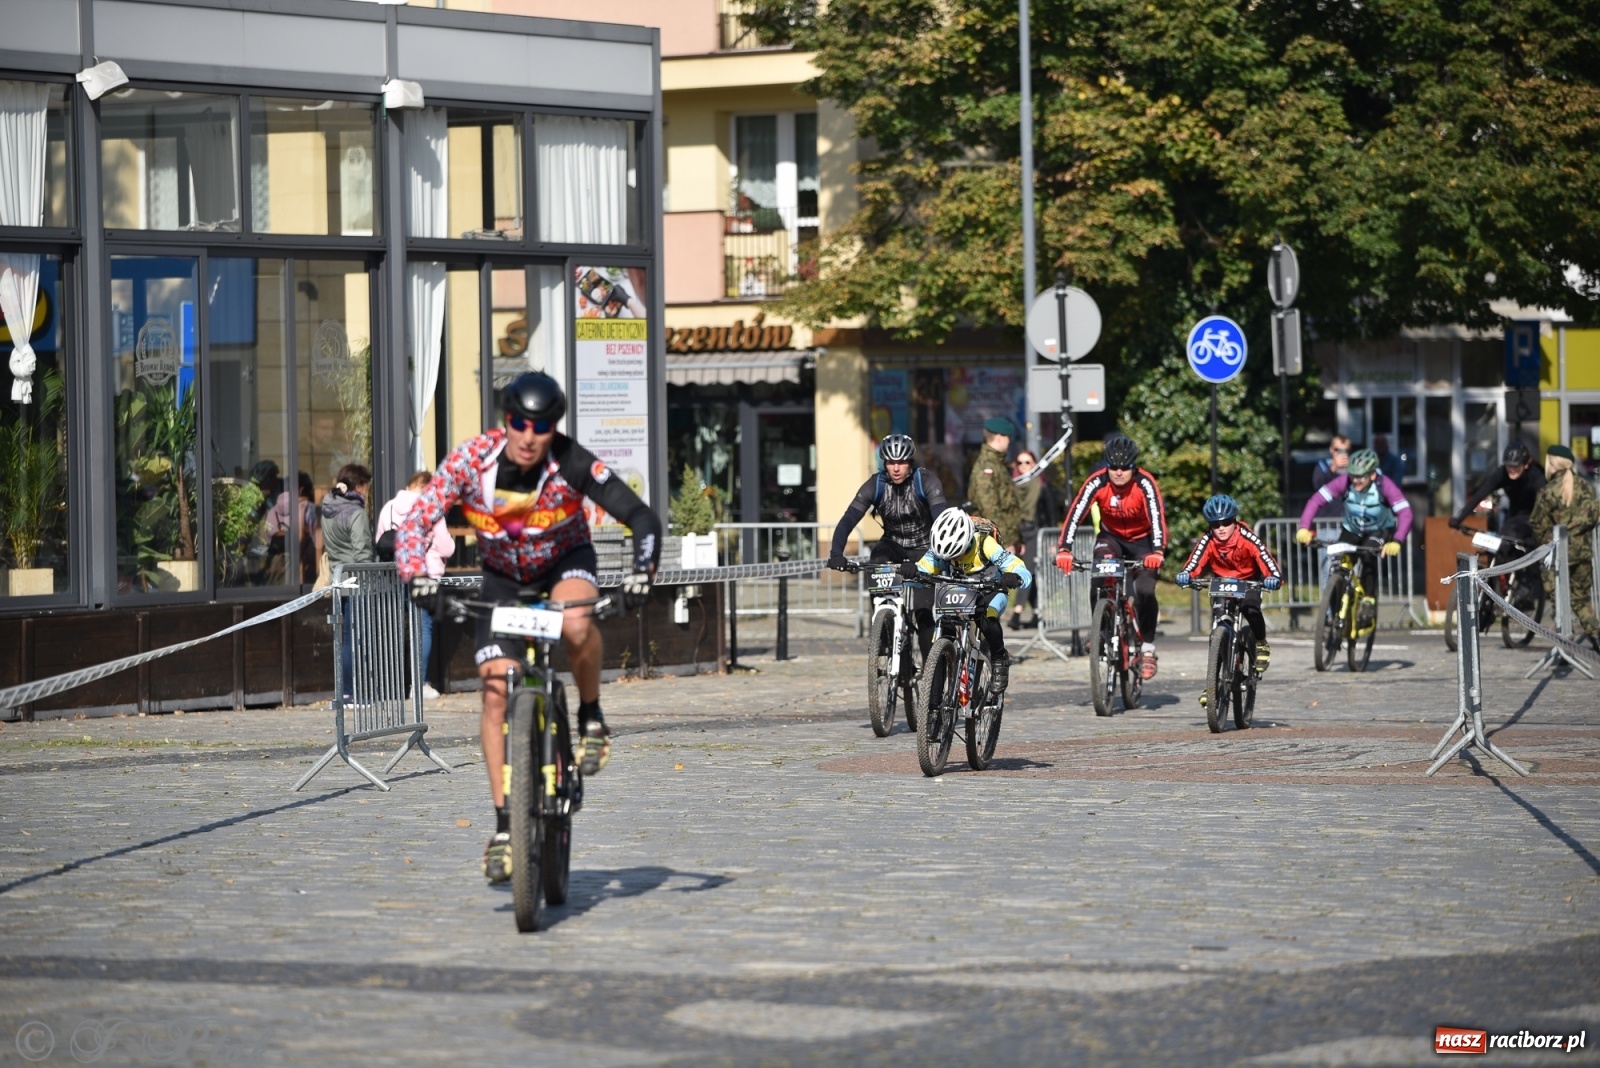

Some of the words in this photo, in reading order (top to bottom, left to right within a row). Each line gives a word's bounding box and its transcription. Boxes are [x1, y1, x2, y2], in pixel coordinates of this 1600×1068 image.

[577, 322, 605, 339] CATERING
[607, 322, 645, 339] DIETETYCZNY
[606, 343, 616, 355] BEZ
[618, 343, 644, 355] PSZENICY
[876, 578, 894, 588] 107
[1219, 583, 1238, 592] 168
[945, 593, 967, 605] 107
